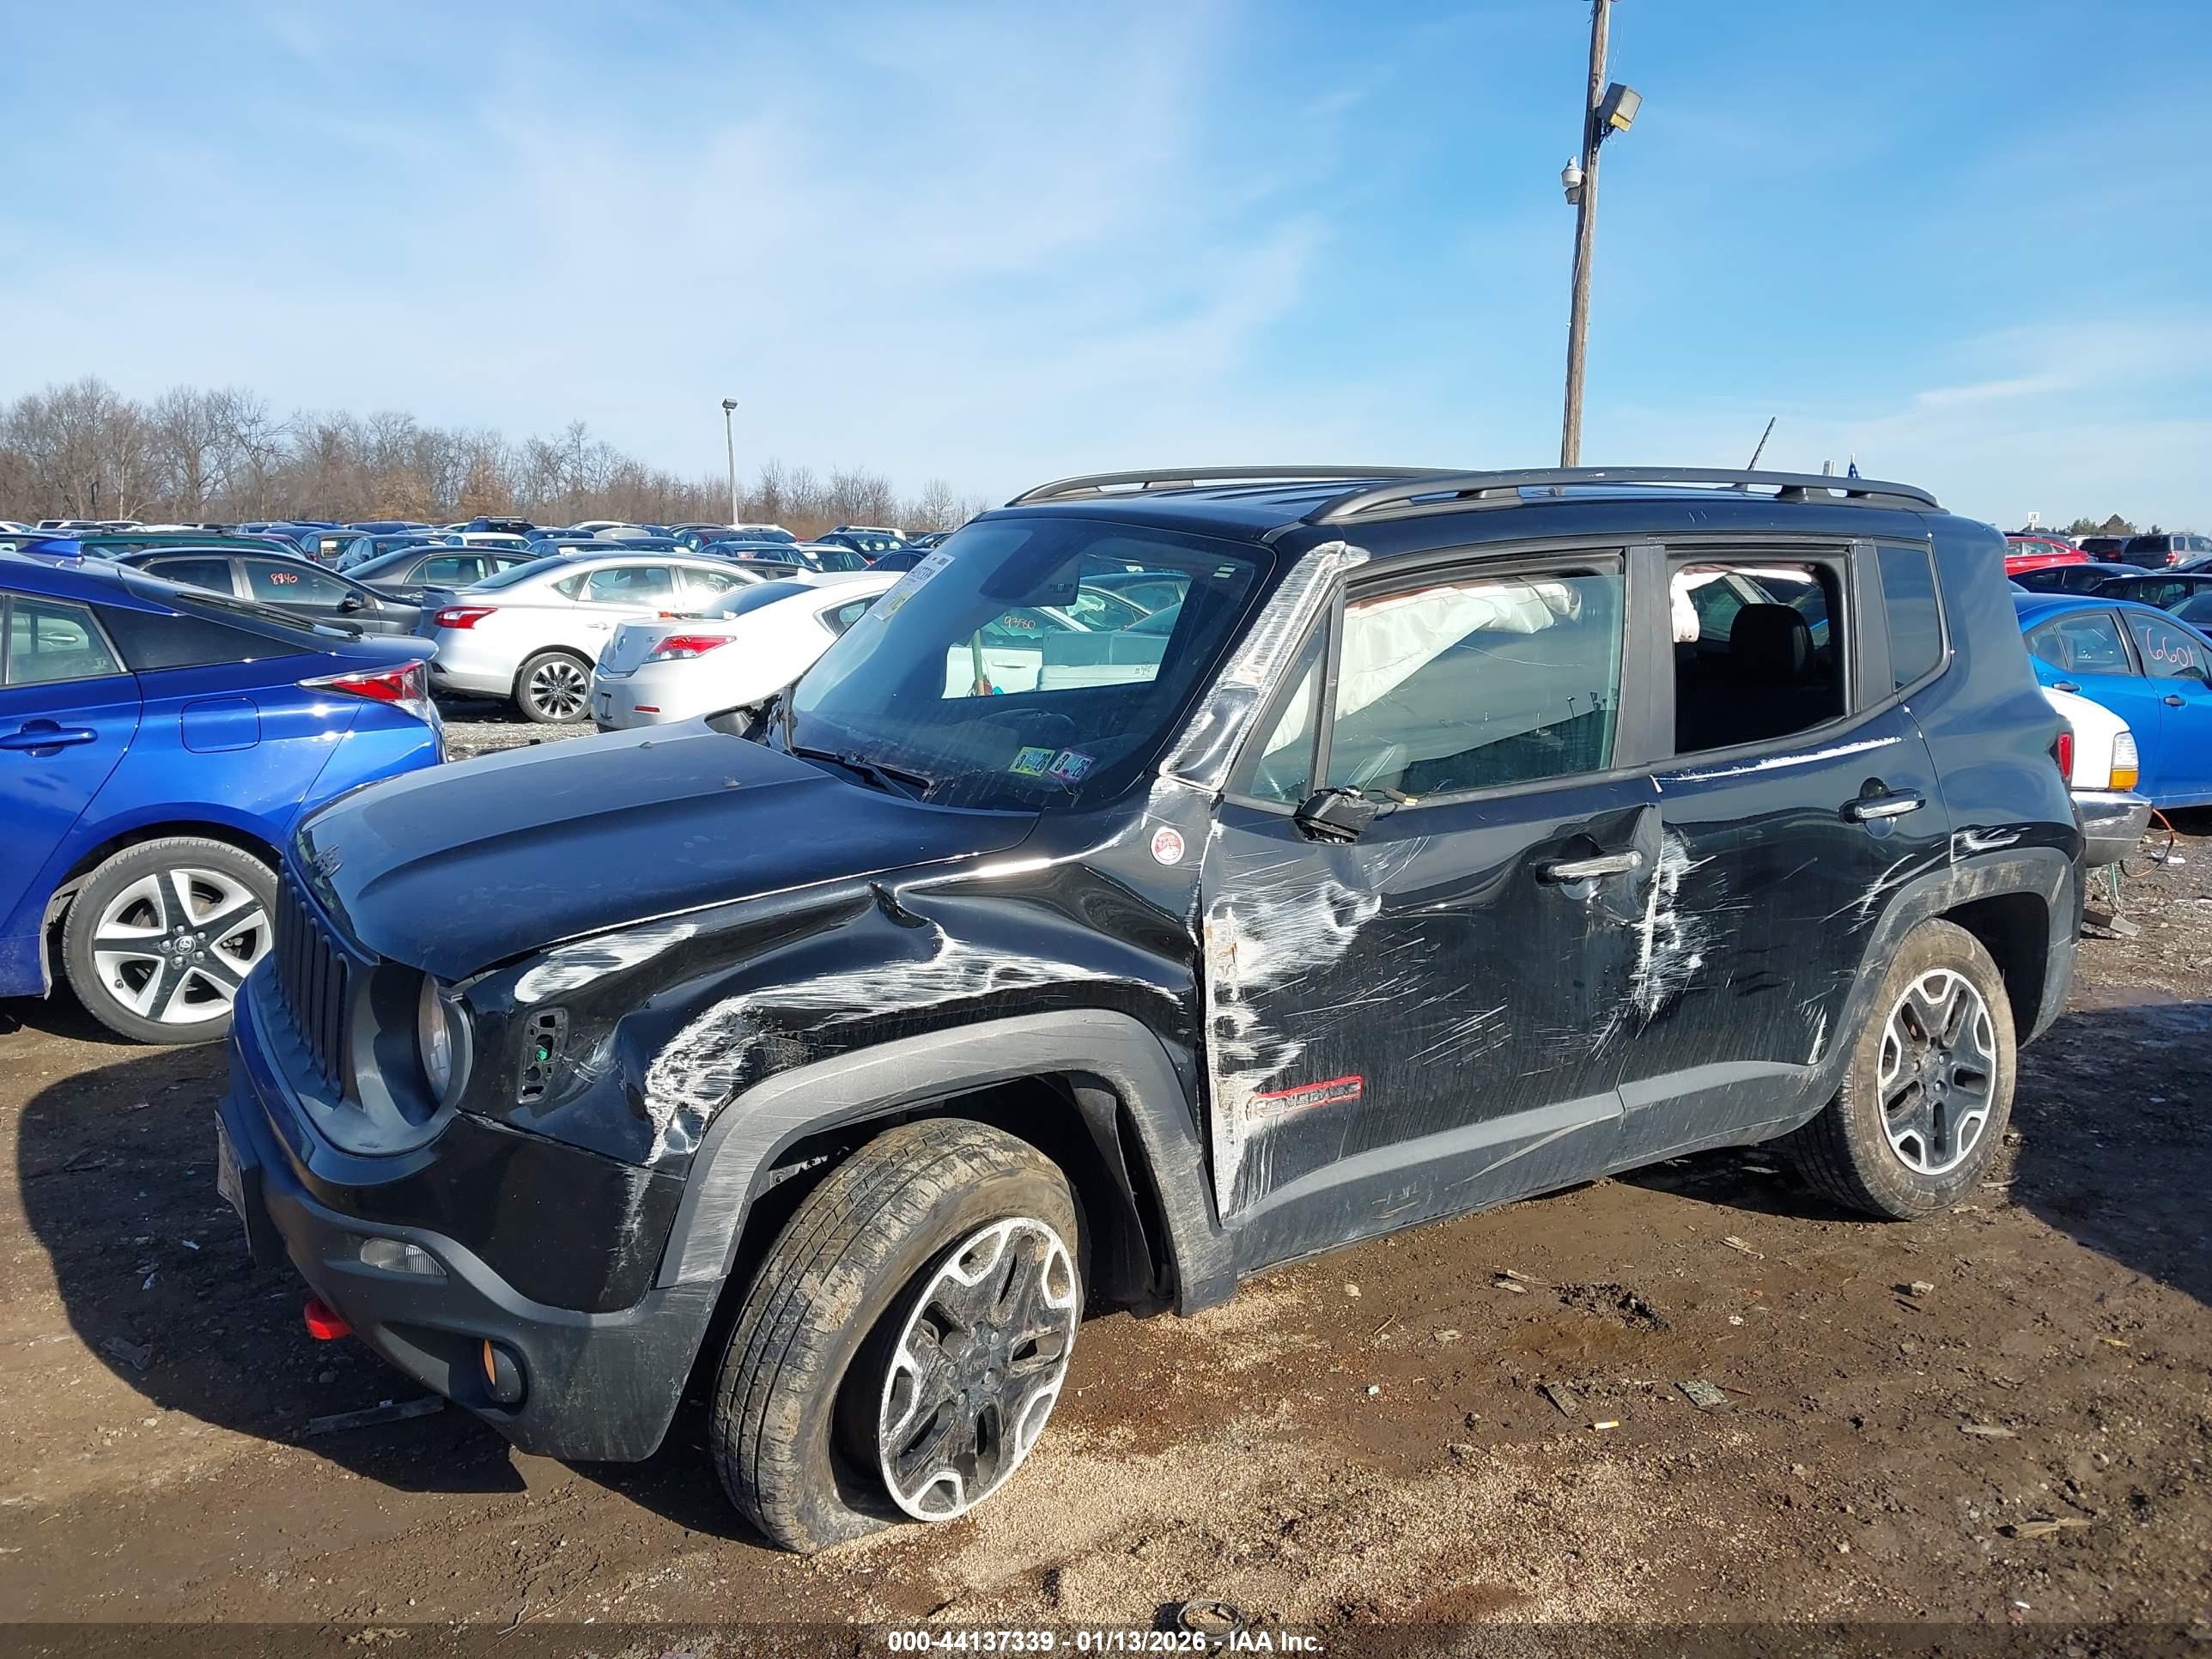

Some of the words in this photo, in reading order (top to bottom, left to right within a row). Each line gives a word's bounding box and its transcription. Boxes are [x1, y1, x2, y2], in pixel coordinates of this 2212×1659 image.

[2147, 628, 2195, 667] 6601
[1015, 754, 1027, 769] 3
[1034, 753, 1051, 771] 26
[1054, 753, 1071, 771] 3
